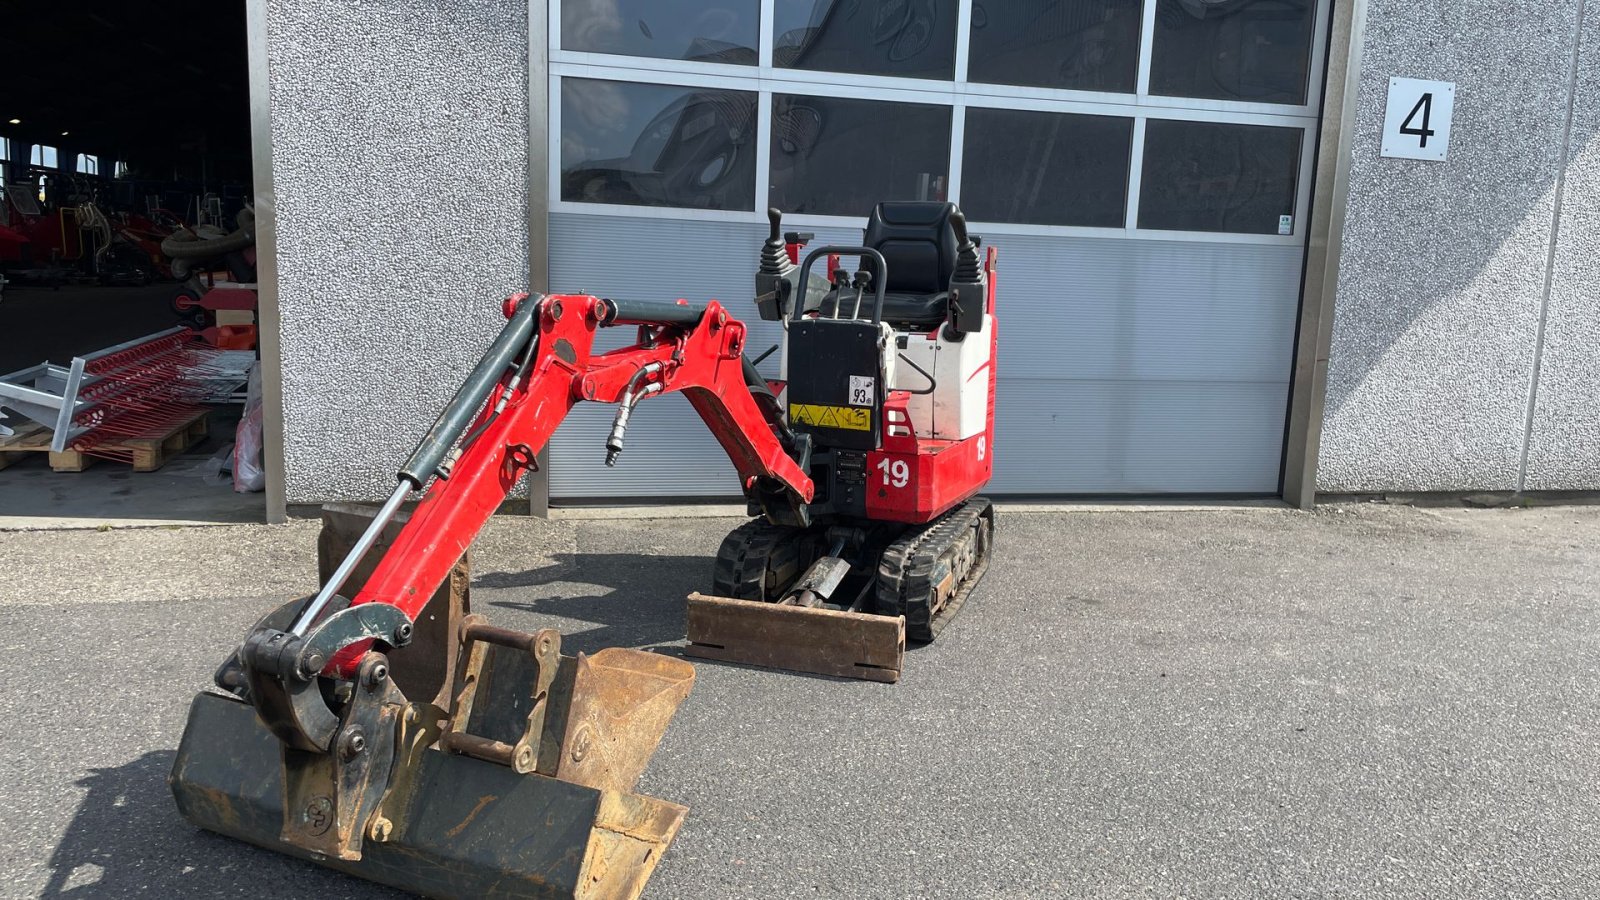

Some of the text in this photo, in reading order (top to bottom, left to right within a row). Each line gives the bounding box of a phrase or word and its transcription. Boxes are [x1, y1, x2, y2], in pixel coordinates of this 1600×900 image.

[1399, 92, 1435, 148] 4
[854, 388, 866, 404] 93
[976, 435, 986, 462] 19
[877, 457, 909, 488] 19
